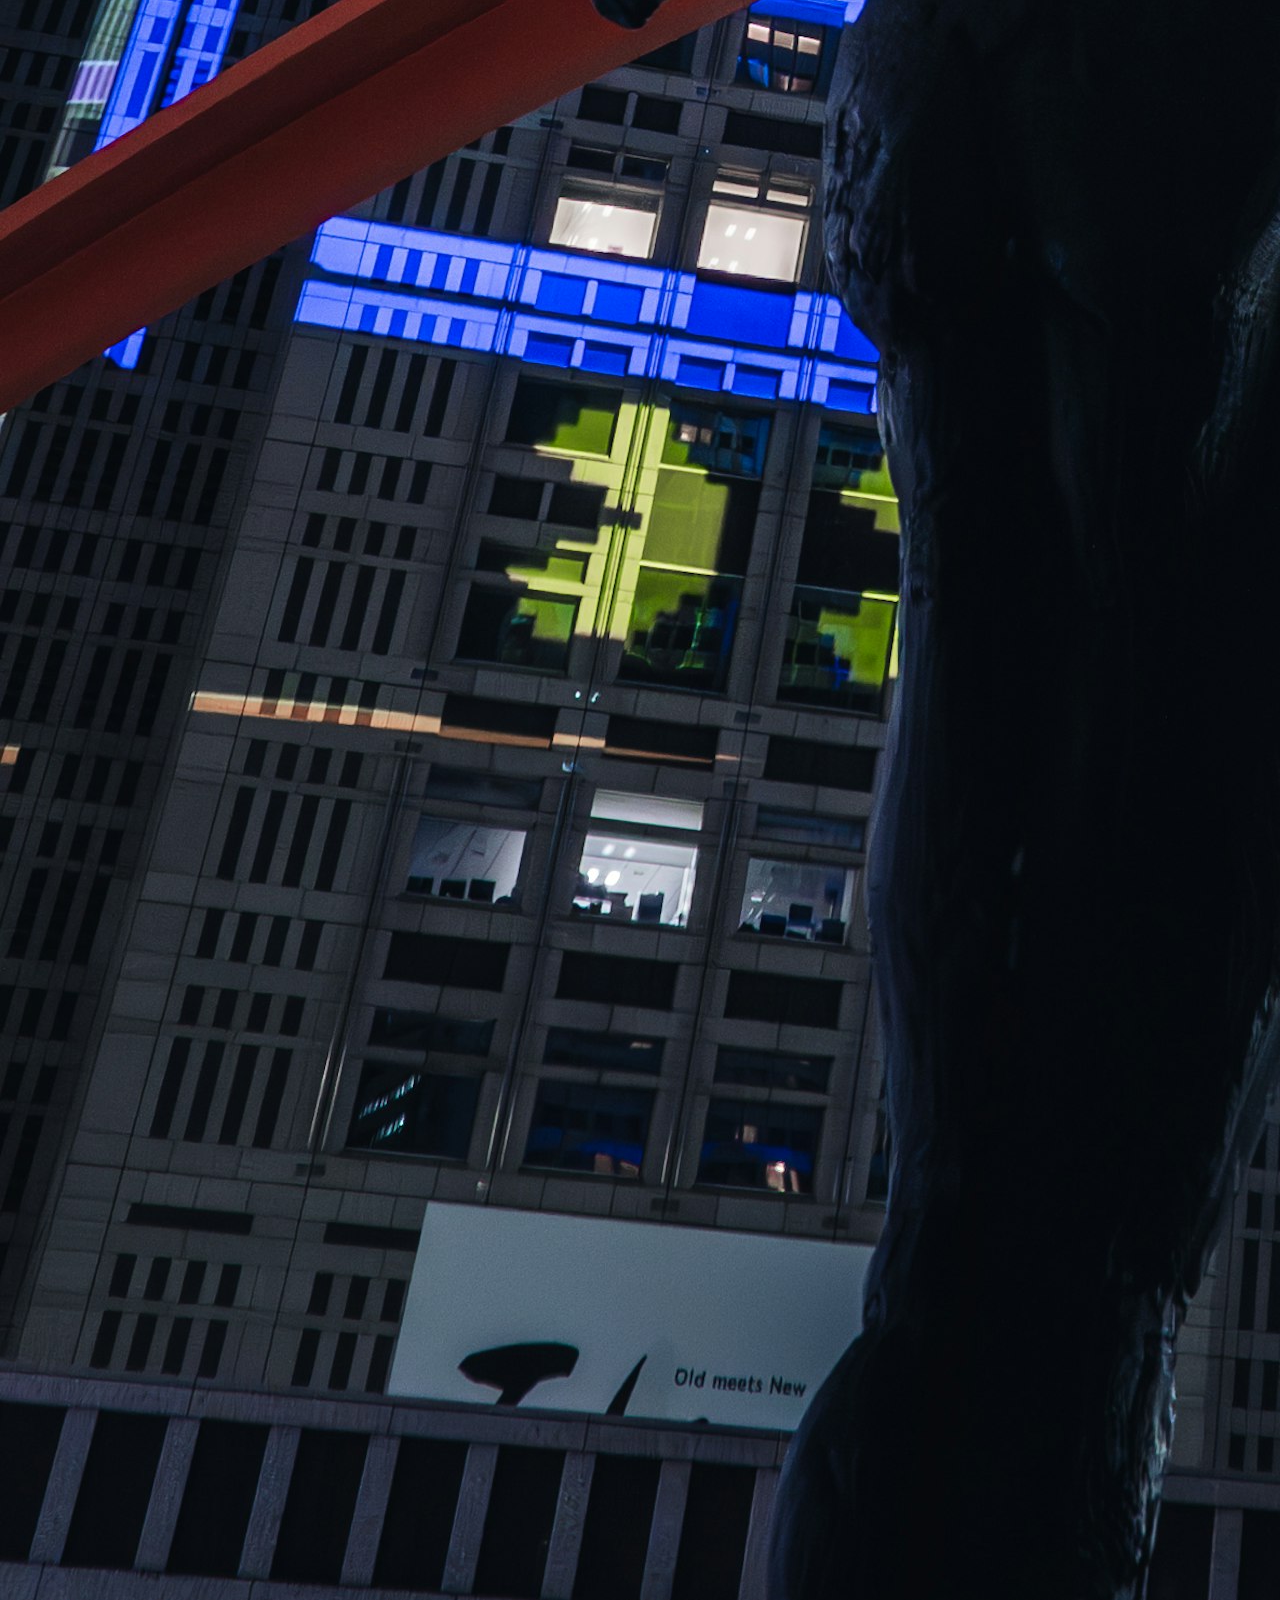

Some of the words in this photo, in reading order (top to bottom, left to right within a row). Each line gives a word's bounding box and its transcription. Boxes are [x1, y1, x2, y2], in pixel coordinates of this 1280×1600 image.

[674, 1367, 707, 1388] Old
[712, 1375, 762, 1394] meets
[770, 1375, 807, 1397] New
